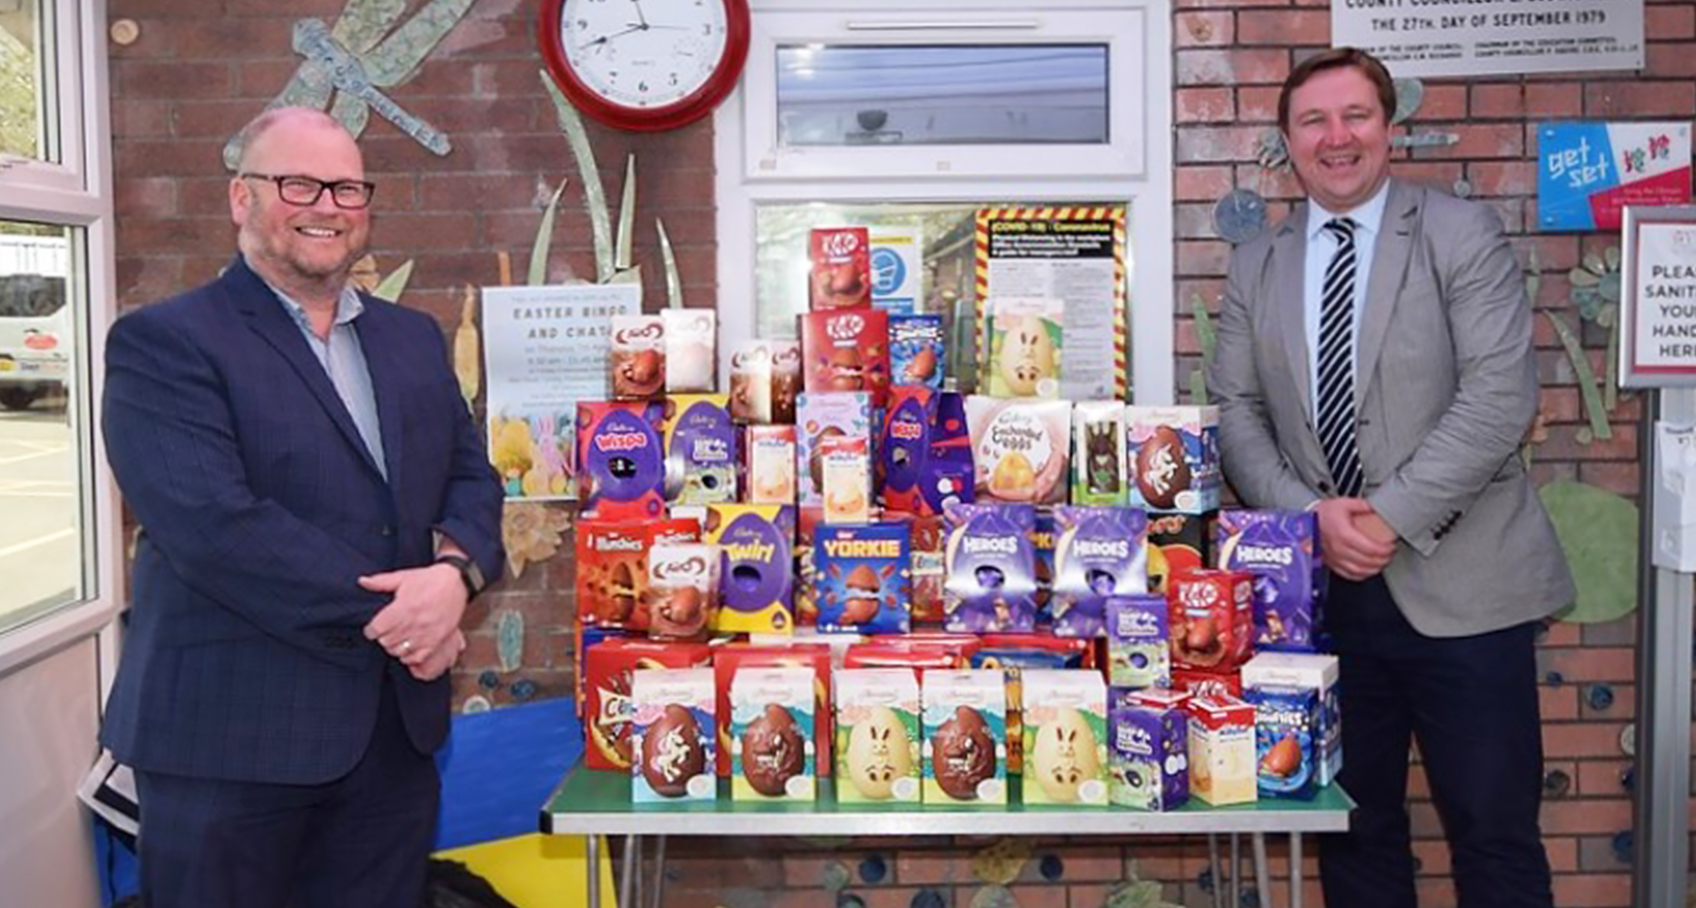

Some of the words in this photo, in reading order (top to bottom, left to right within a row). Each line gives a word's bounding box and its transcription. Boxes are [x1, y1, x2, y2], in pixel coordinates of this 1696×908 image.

[1371, 18, 1396, 31] THE
[1440, 15, 1466, 29] DAY
[1471, 14, 1487, 28] OF
[1493, 10, 1571, 27] SEPTEMBER
[1575, 9, 1606, 24] 1979
[702, 23, 711, 36] 3
[638, 80, 648, 92] 6
[1548, 136, 1590, 180] get
[1568, 152, 1609, 187] set
[1652, 265, 1696, 279] PLEA
[513, 306, 573, 319] EASTER
[582, 305, 627, 318] BINGO
[1660, 304, 1696, 319] YOU
[528, 327, 559, 340] AND
[1660, 342, 1696, 358] HER
[823, 540, 901, 558] YORKIE
[963, 535, 1018, 554] HEROES
[1073, 539, 1128, 558] HEROES
[1236, 545, 1293, 565] HEROES
